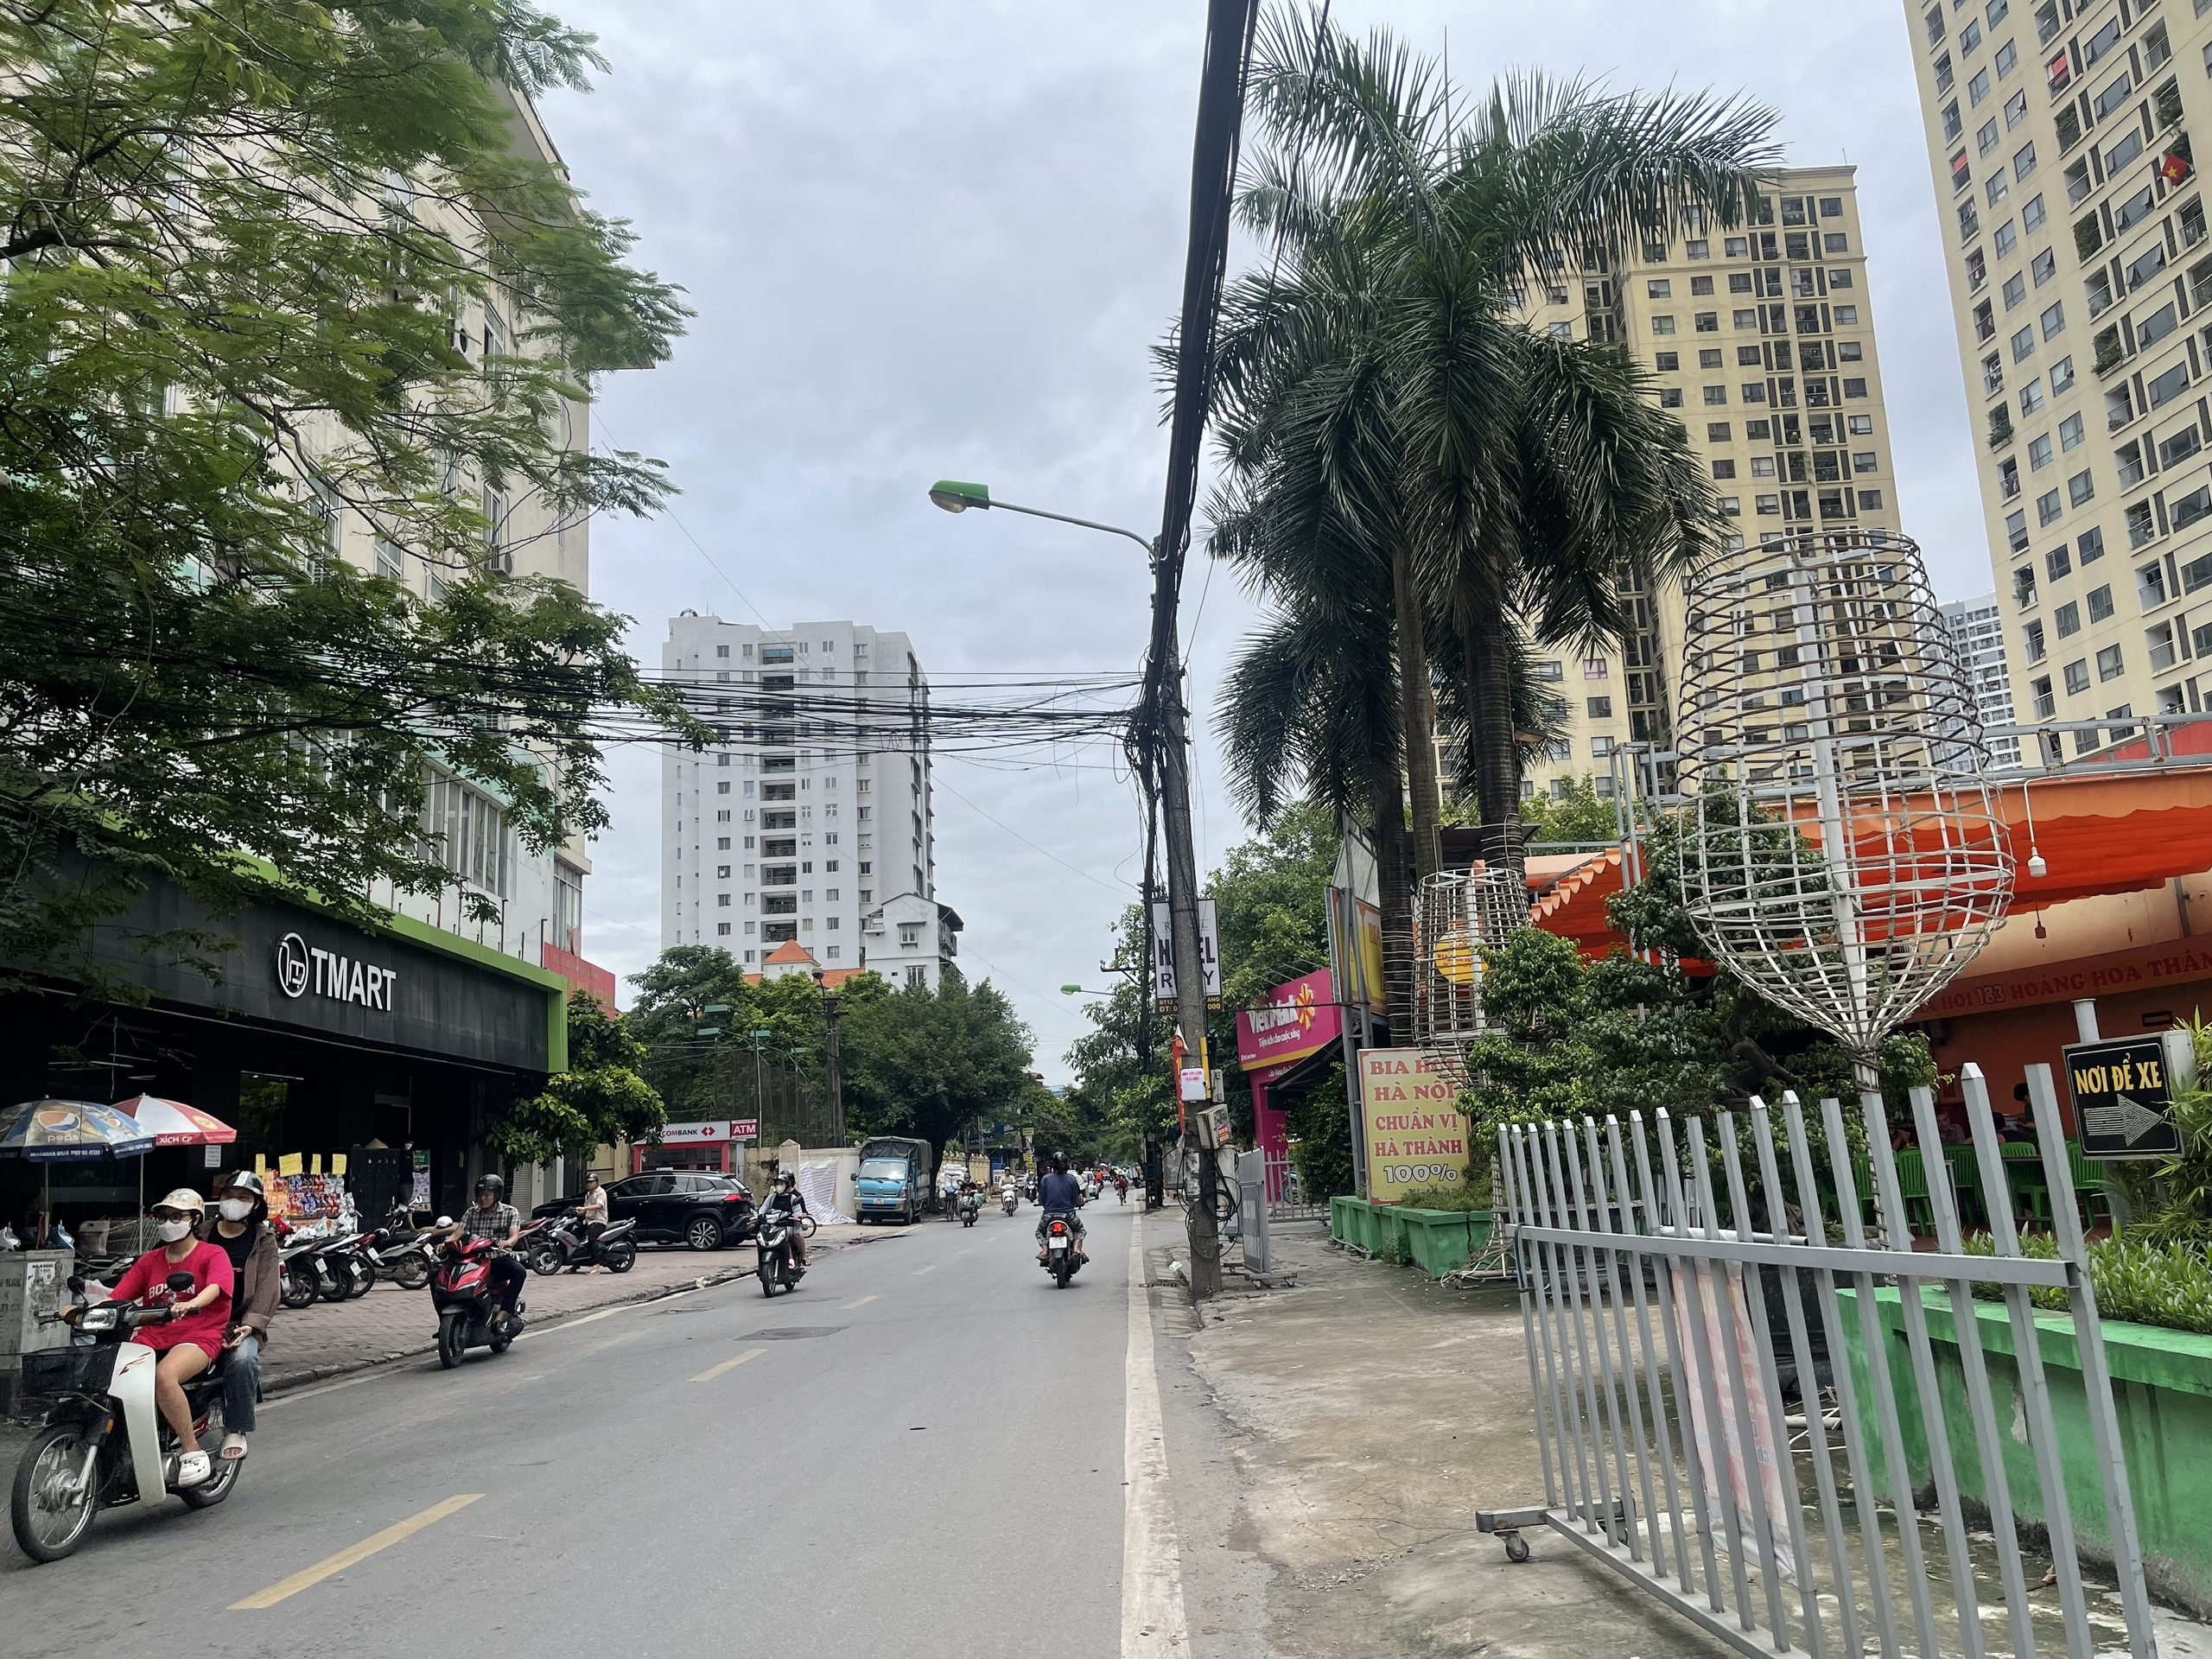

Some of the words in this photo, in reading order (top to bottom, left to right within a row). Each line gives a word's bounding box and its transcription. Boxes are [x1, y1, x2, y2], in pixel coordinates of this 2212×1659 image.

[310, 946, 397, 1012] TMART
[1974, 983, 2006, 1007] 183
[2011, 973, 2085, 1001] HOÀNG
[2093, 966, 2143, 988] HOA
[1370, 1060, 1410, 1075] BIA
[2074, 1065, 2109, 1094] NƠI
[2111, 1052, 2134, 1091] ĐỂ
[2135, 1061, 2162, 1090] XE
[1374, 1082, 1408, 1101] HÀ
[1413, 1080, 1455, 1103] NỘI
[733, 1123, 756, 1135] ATM
[1375, 1107, 1434, 1130] CHUẨN
[1439, 1114, 1459, 1132] VỊ
[661, 1128, 698, 1137] COMBANK
[1374, 1137, 1400, 1157] HÀ
[1402, 1136, 1463, 1155] THÀNH
[1383, 1164, 1458, 1184] 100%
